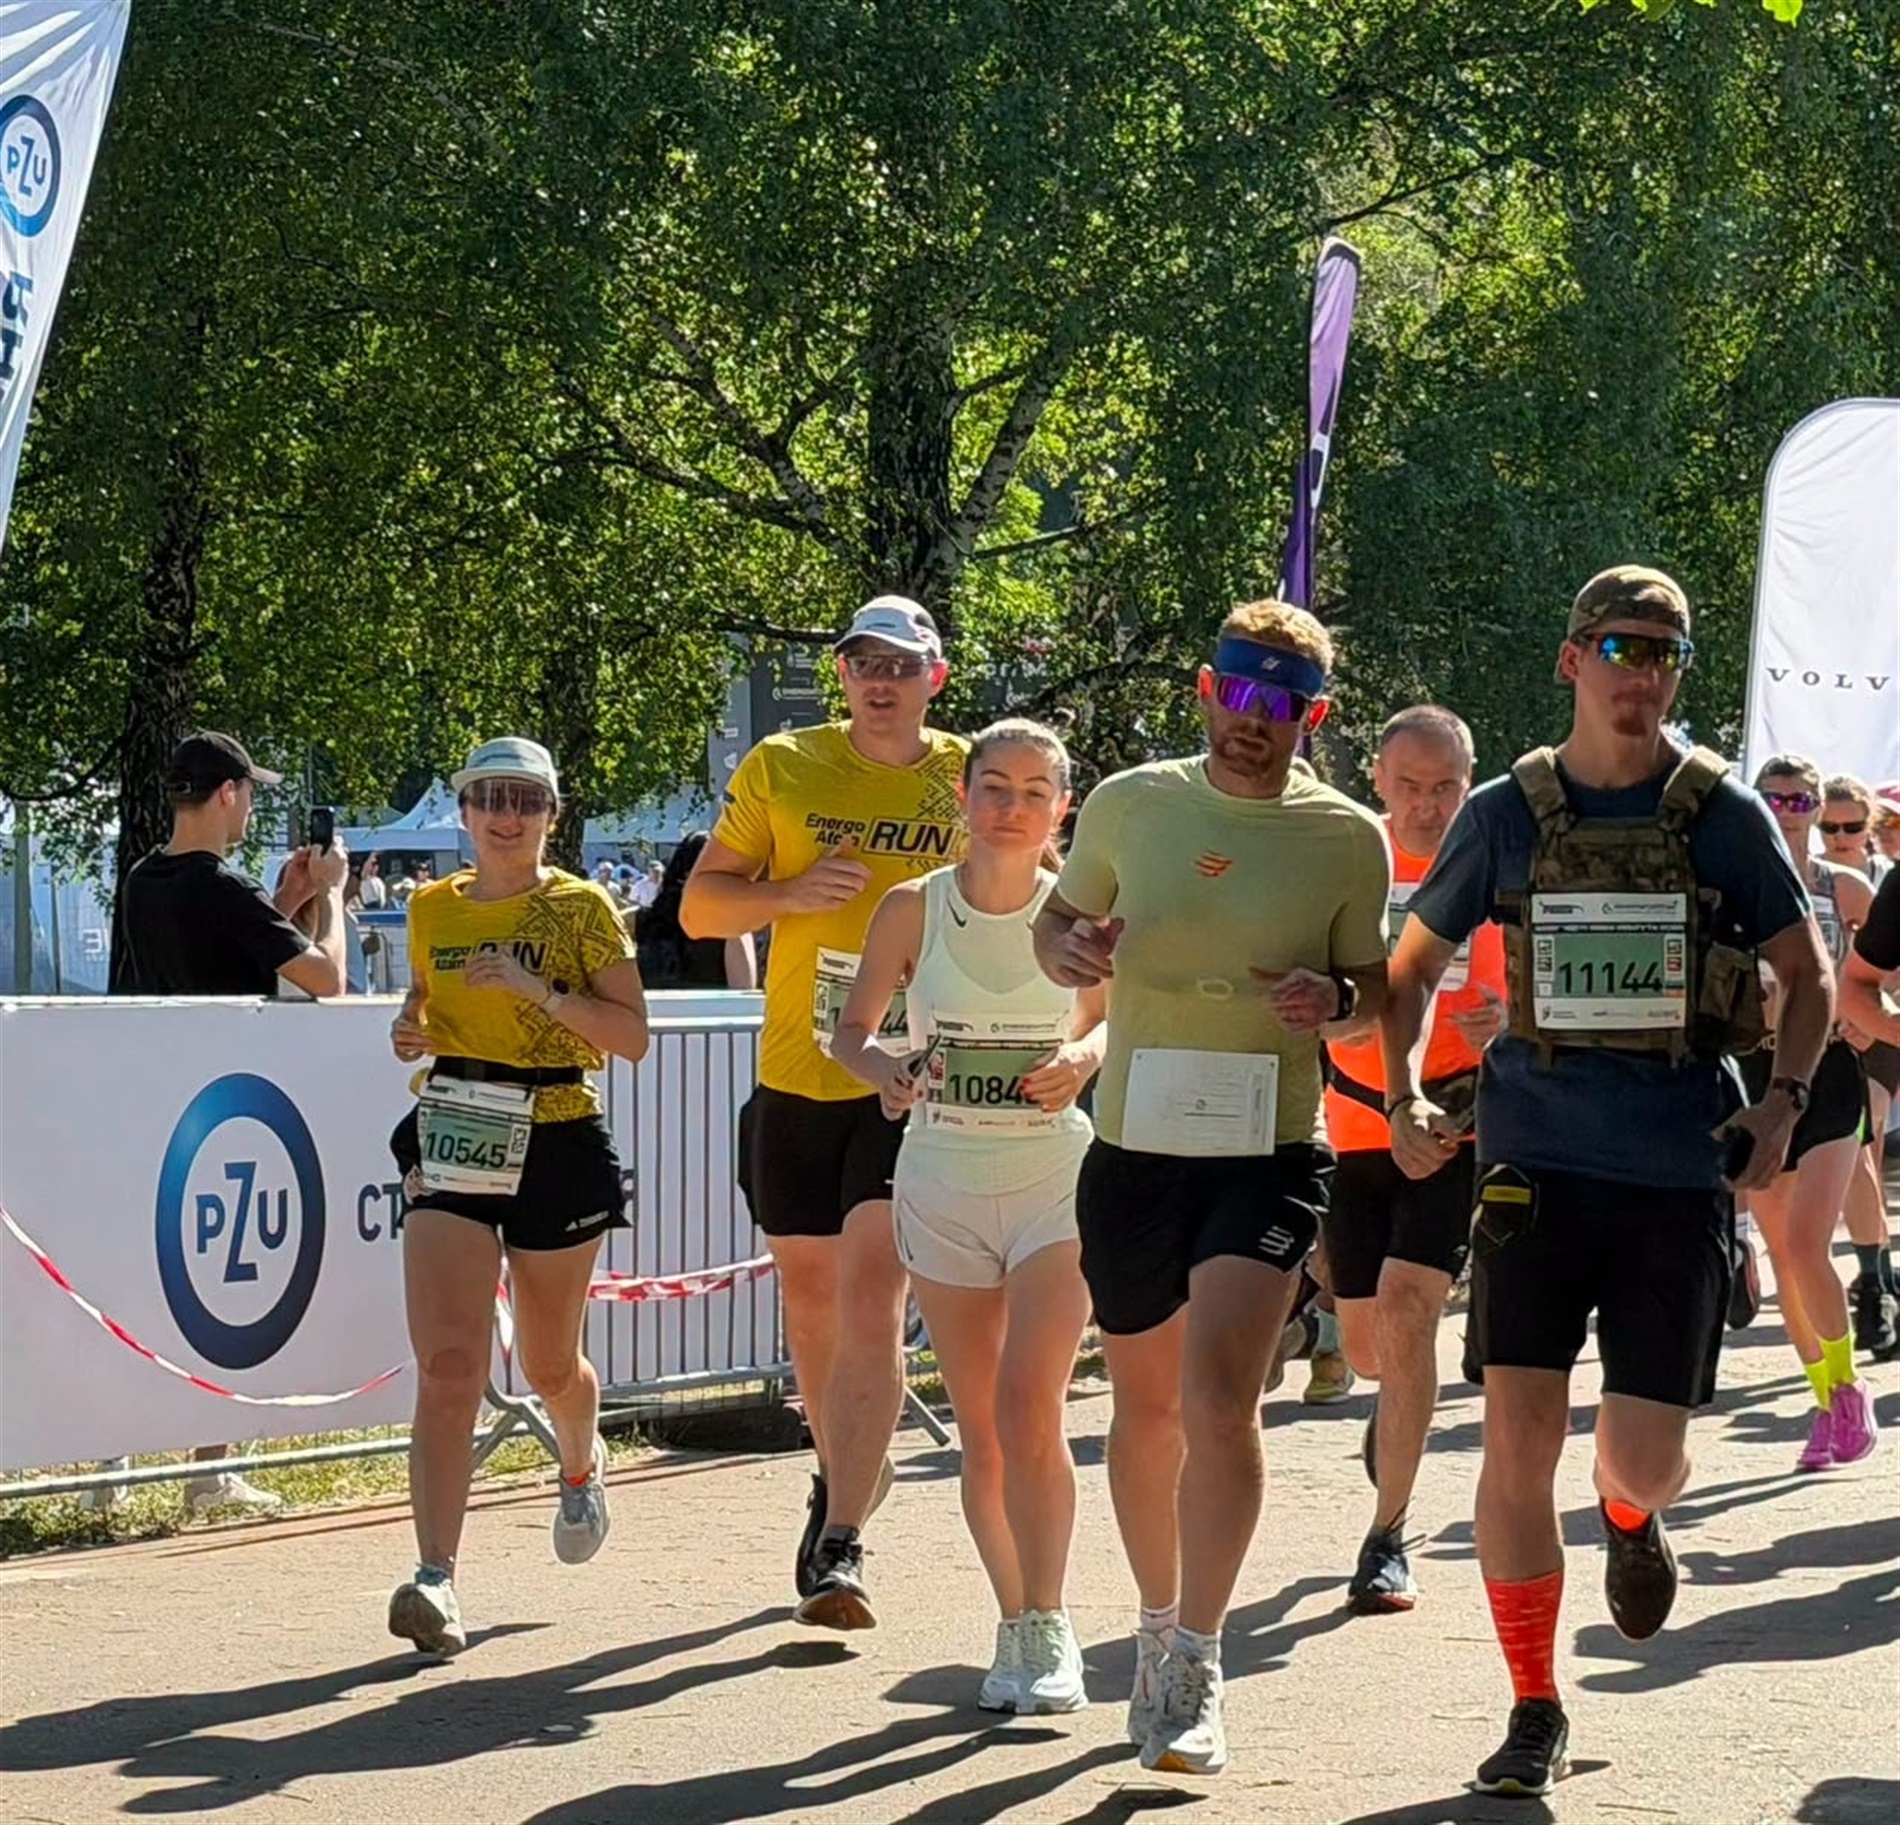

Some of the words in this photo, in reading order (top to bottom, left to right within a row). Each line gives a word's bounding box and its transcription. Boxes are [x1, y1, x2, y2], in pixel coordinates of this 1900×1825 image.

[7, 135, 47, 197] PZU
[1766, 667, 1891, 691] VOLV
[804, 812, 866, 834] Energo
[870, 821, 953, 856] RUN
[1558, 960, 1664, 995] 11144
[949, 1073, 1041, 1106] 1084
[426, 1131, 508, 1170] 10545
[195, 1160, 289, 1284] PZU
